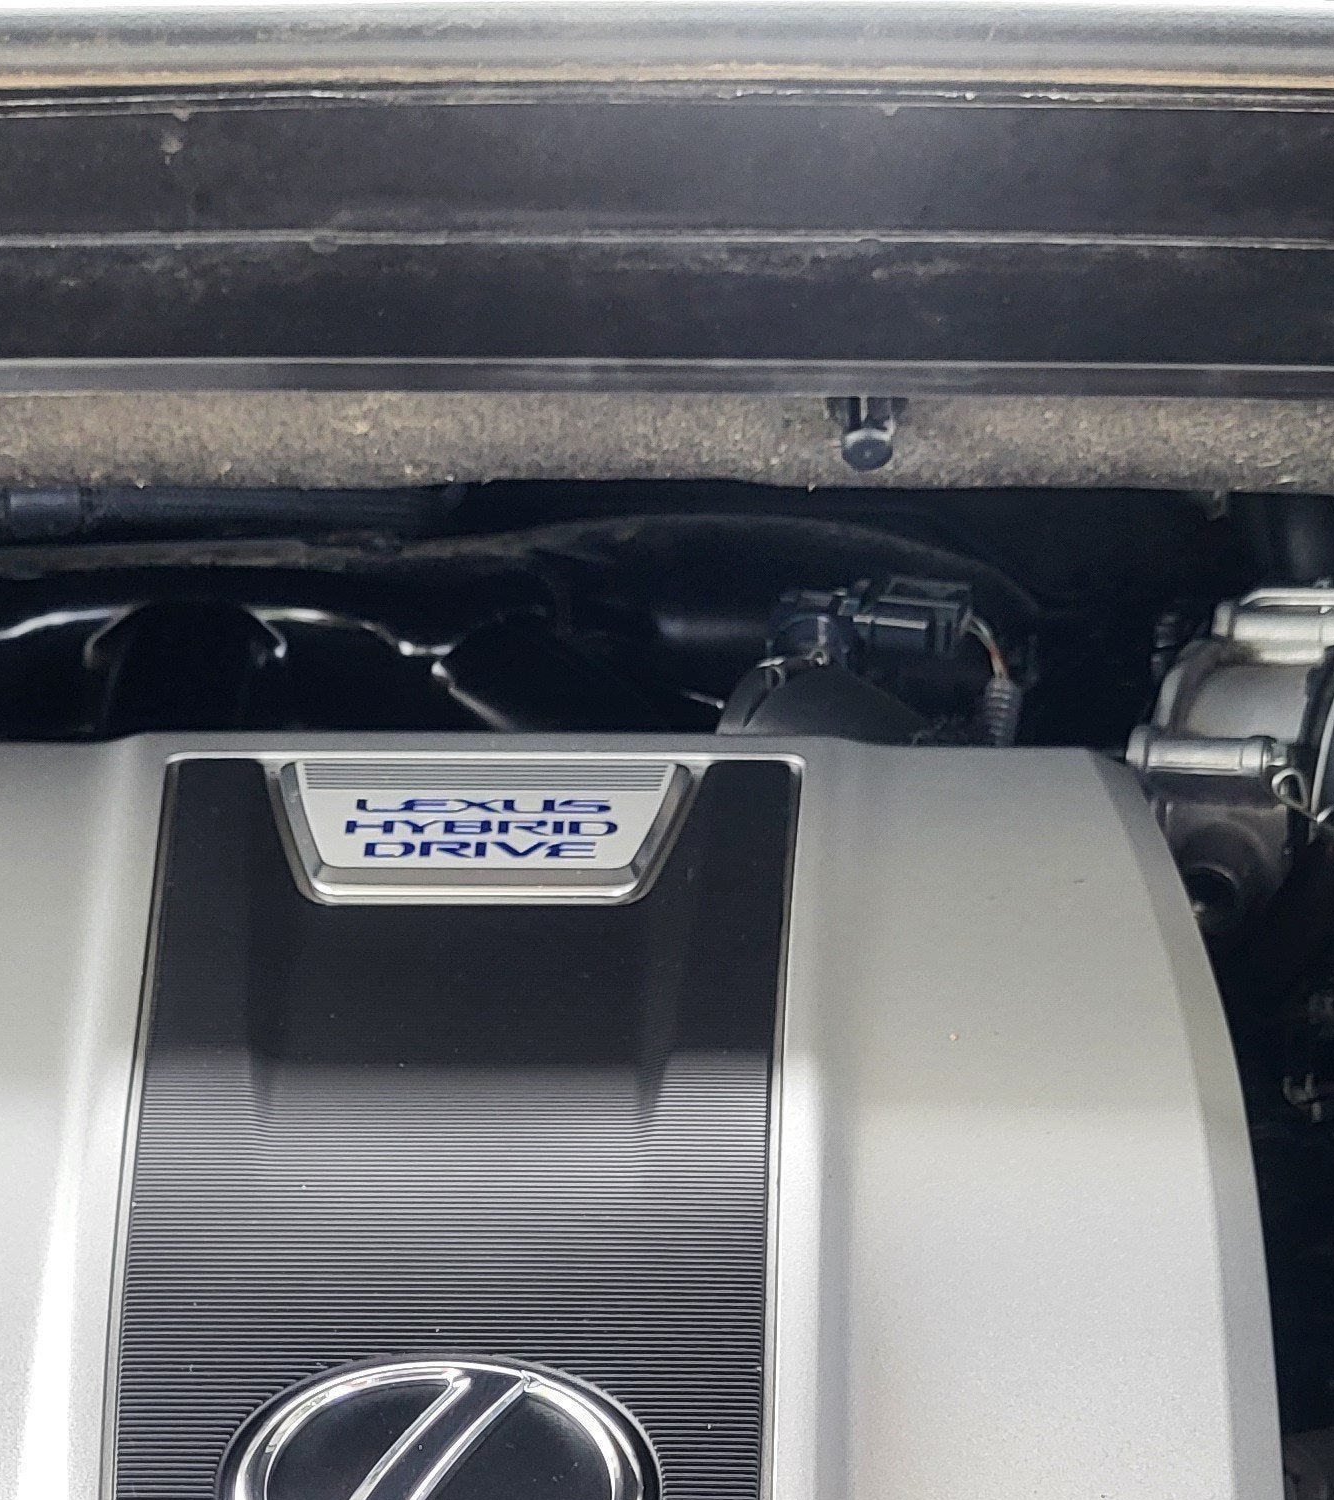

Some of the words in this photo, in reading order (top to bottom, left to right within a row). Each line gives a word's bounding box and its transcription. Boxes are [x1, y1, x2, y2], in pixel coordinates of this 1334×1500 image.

[355, 798, 612, 815] LEXUS
[344, 819, 618, 836] HYBRID
[363, 841, 597, 859] DRIVE
